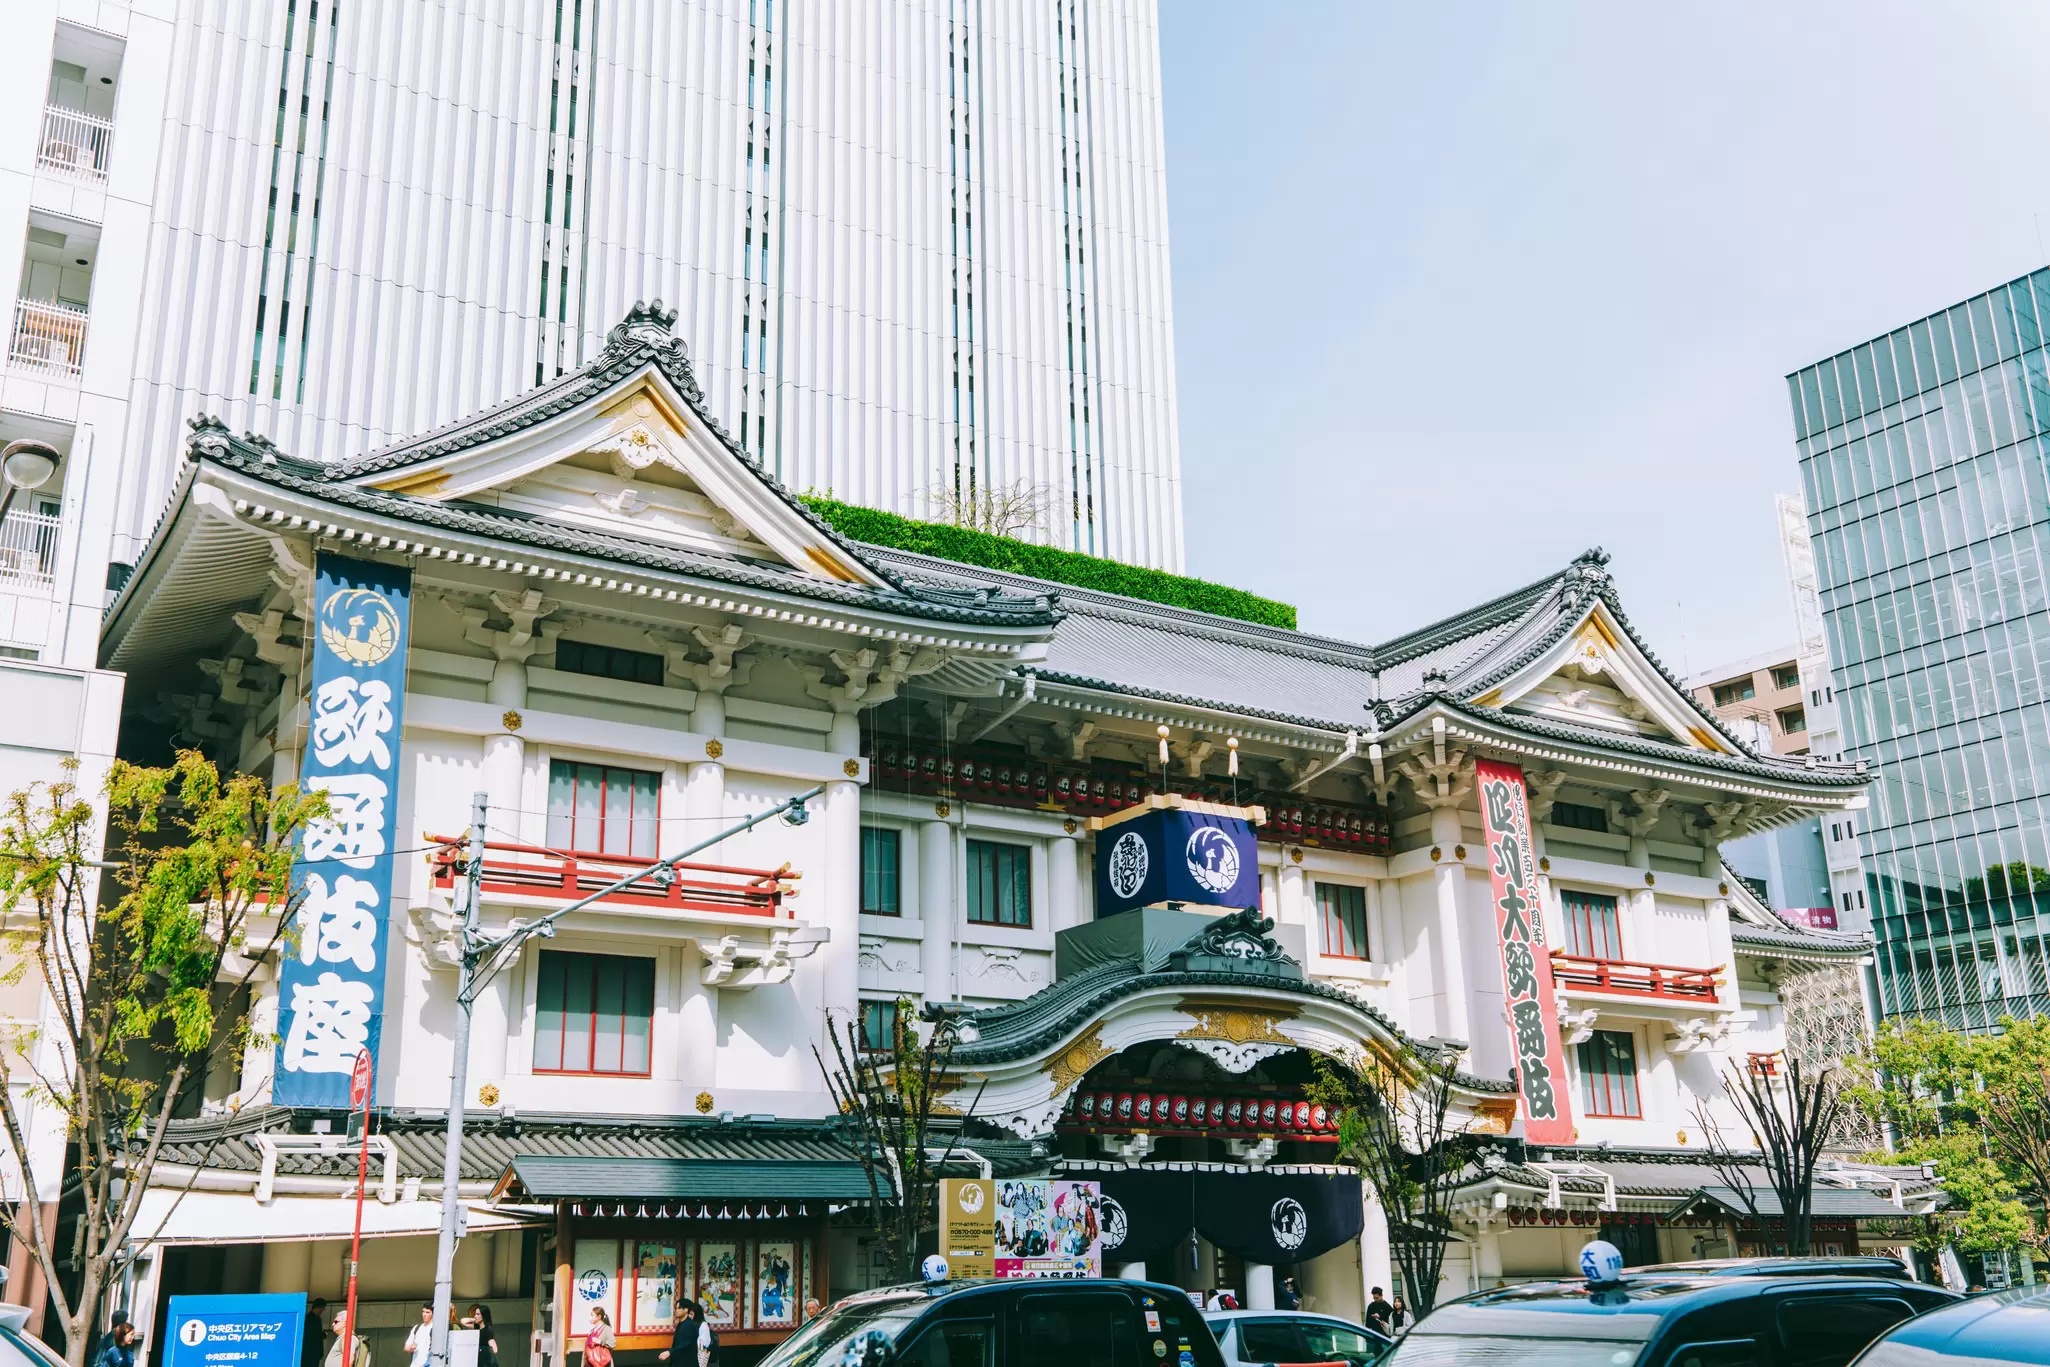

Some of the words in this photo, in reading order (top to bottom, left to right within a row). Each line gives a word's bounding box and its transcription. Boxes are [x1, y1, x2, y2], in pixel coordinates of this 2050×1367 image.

[283, 676, 393, 1076] 歌舞伎座
[1483, 779, 1556, 1120] 四月大歌舞伎
[936, 1264, 947, 1273] 441
[1581, 1249, 1602, 1280] 大和
[207, 1334, 227, 1342] Chuo
[228, 1333, 242, 1342] City
[243, 1333, 260, 1341] Area
[260, 1333, 276, 1341] Map
[208, 1323, 282, 1334] 中央区エリアマップ
